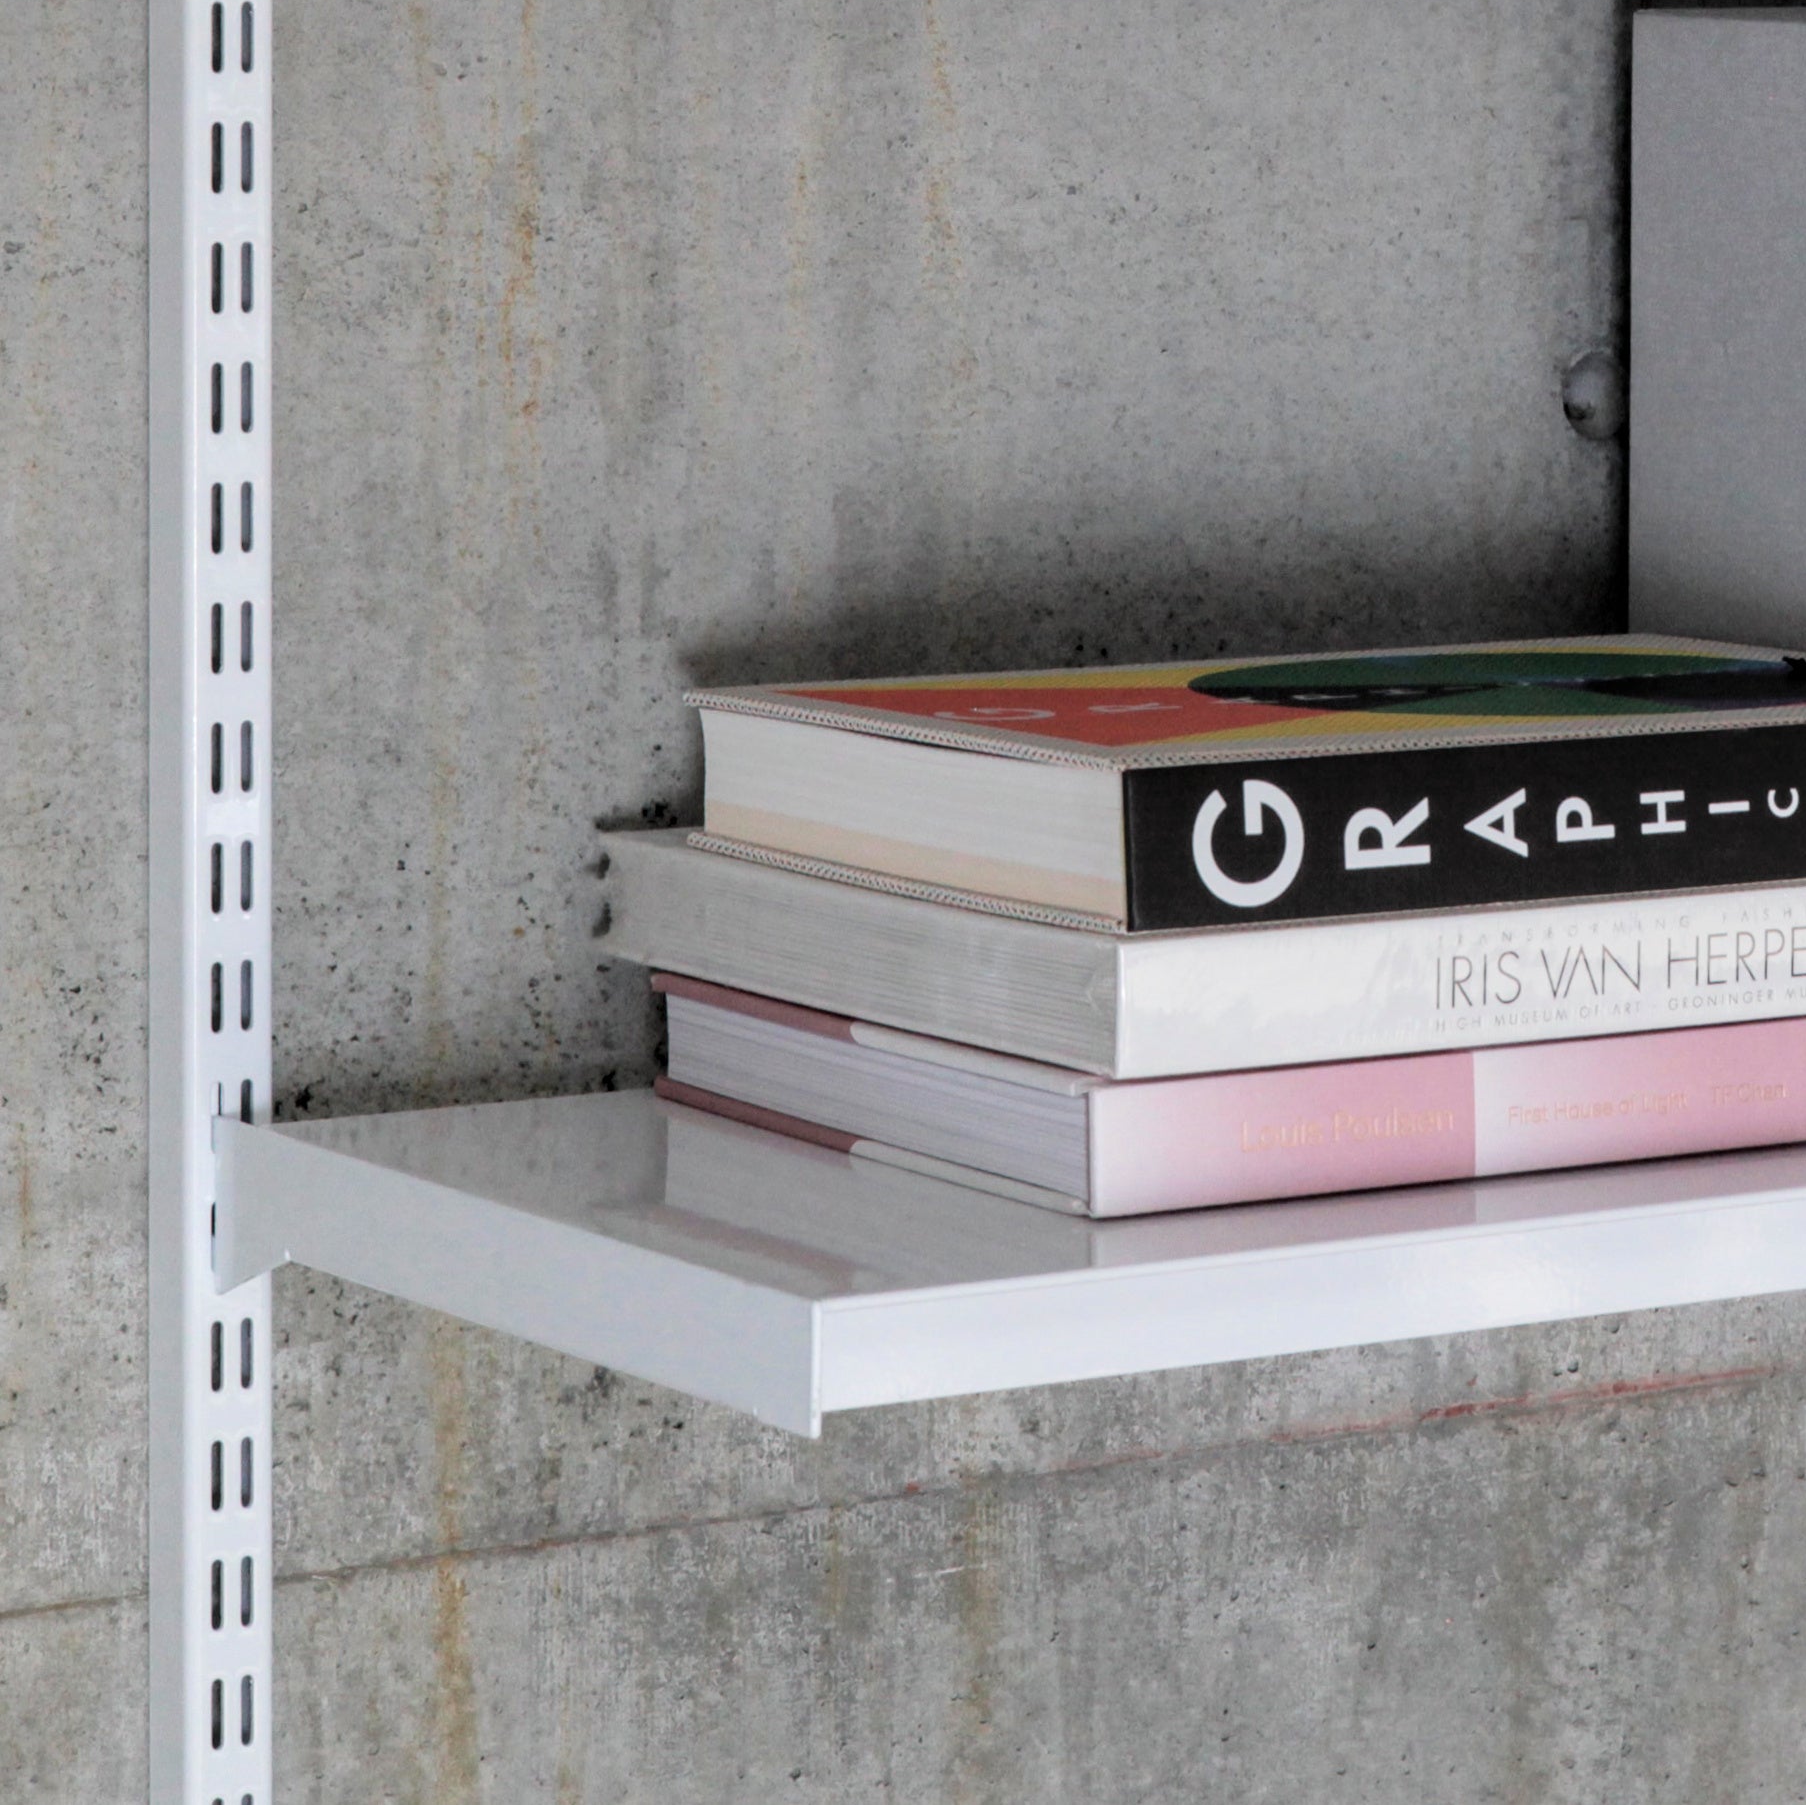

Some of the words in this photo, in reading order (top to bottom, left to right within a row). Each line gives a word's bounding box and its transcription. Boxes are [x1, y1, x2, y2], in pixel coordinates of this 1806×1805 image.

[1192, 778, 1799, 908] GRAPHIC
[1435, 950, 1521, 1010] IRIS
[1540, 940, 1641, 998] VAN
[1495, 1008, 1568, 1027] MUSEUM
[1668, 988, 1775, 1012] GRONINGER
[1241, 1114, 1324, 1153] Louis
[1332, 1106, 1453, 1142] Poulsen
[1508, 1103, 1548, 1125] First
[1554, 1099, 1614, 1122] House
